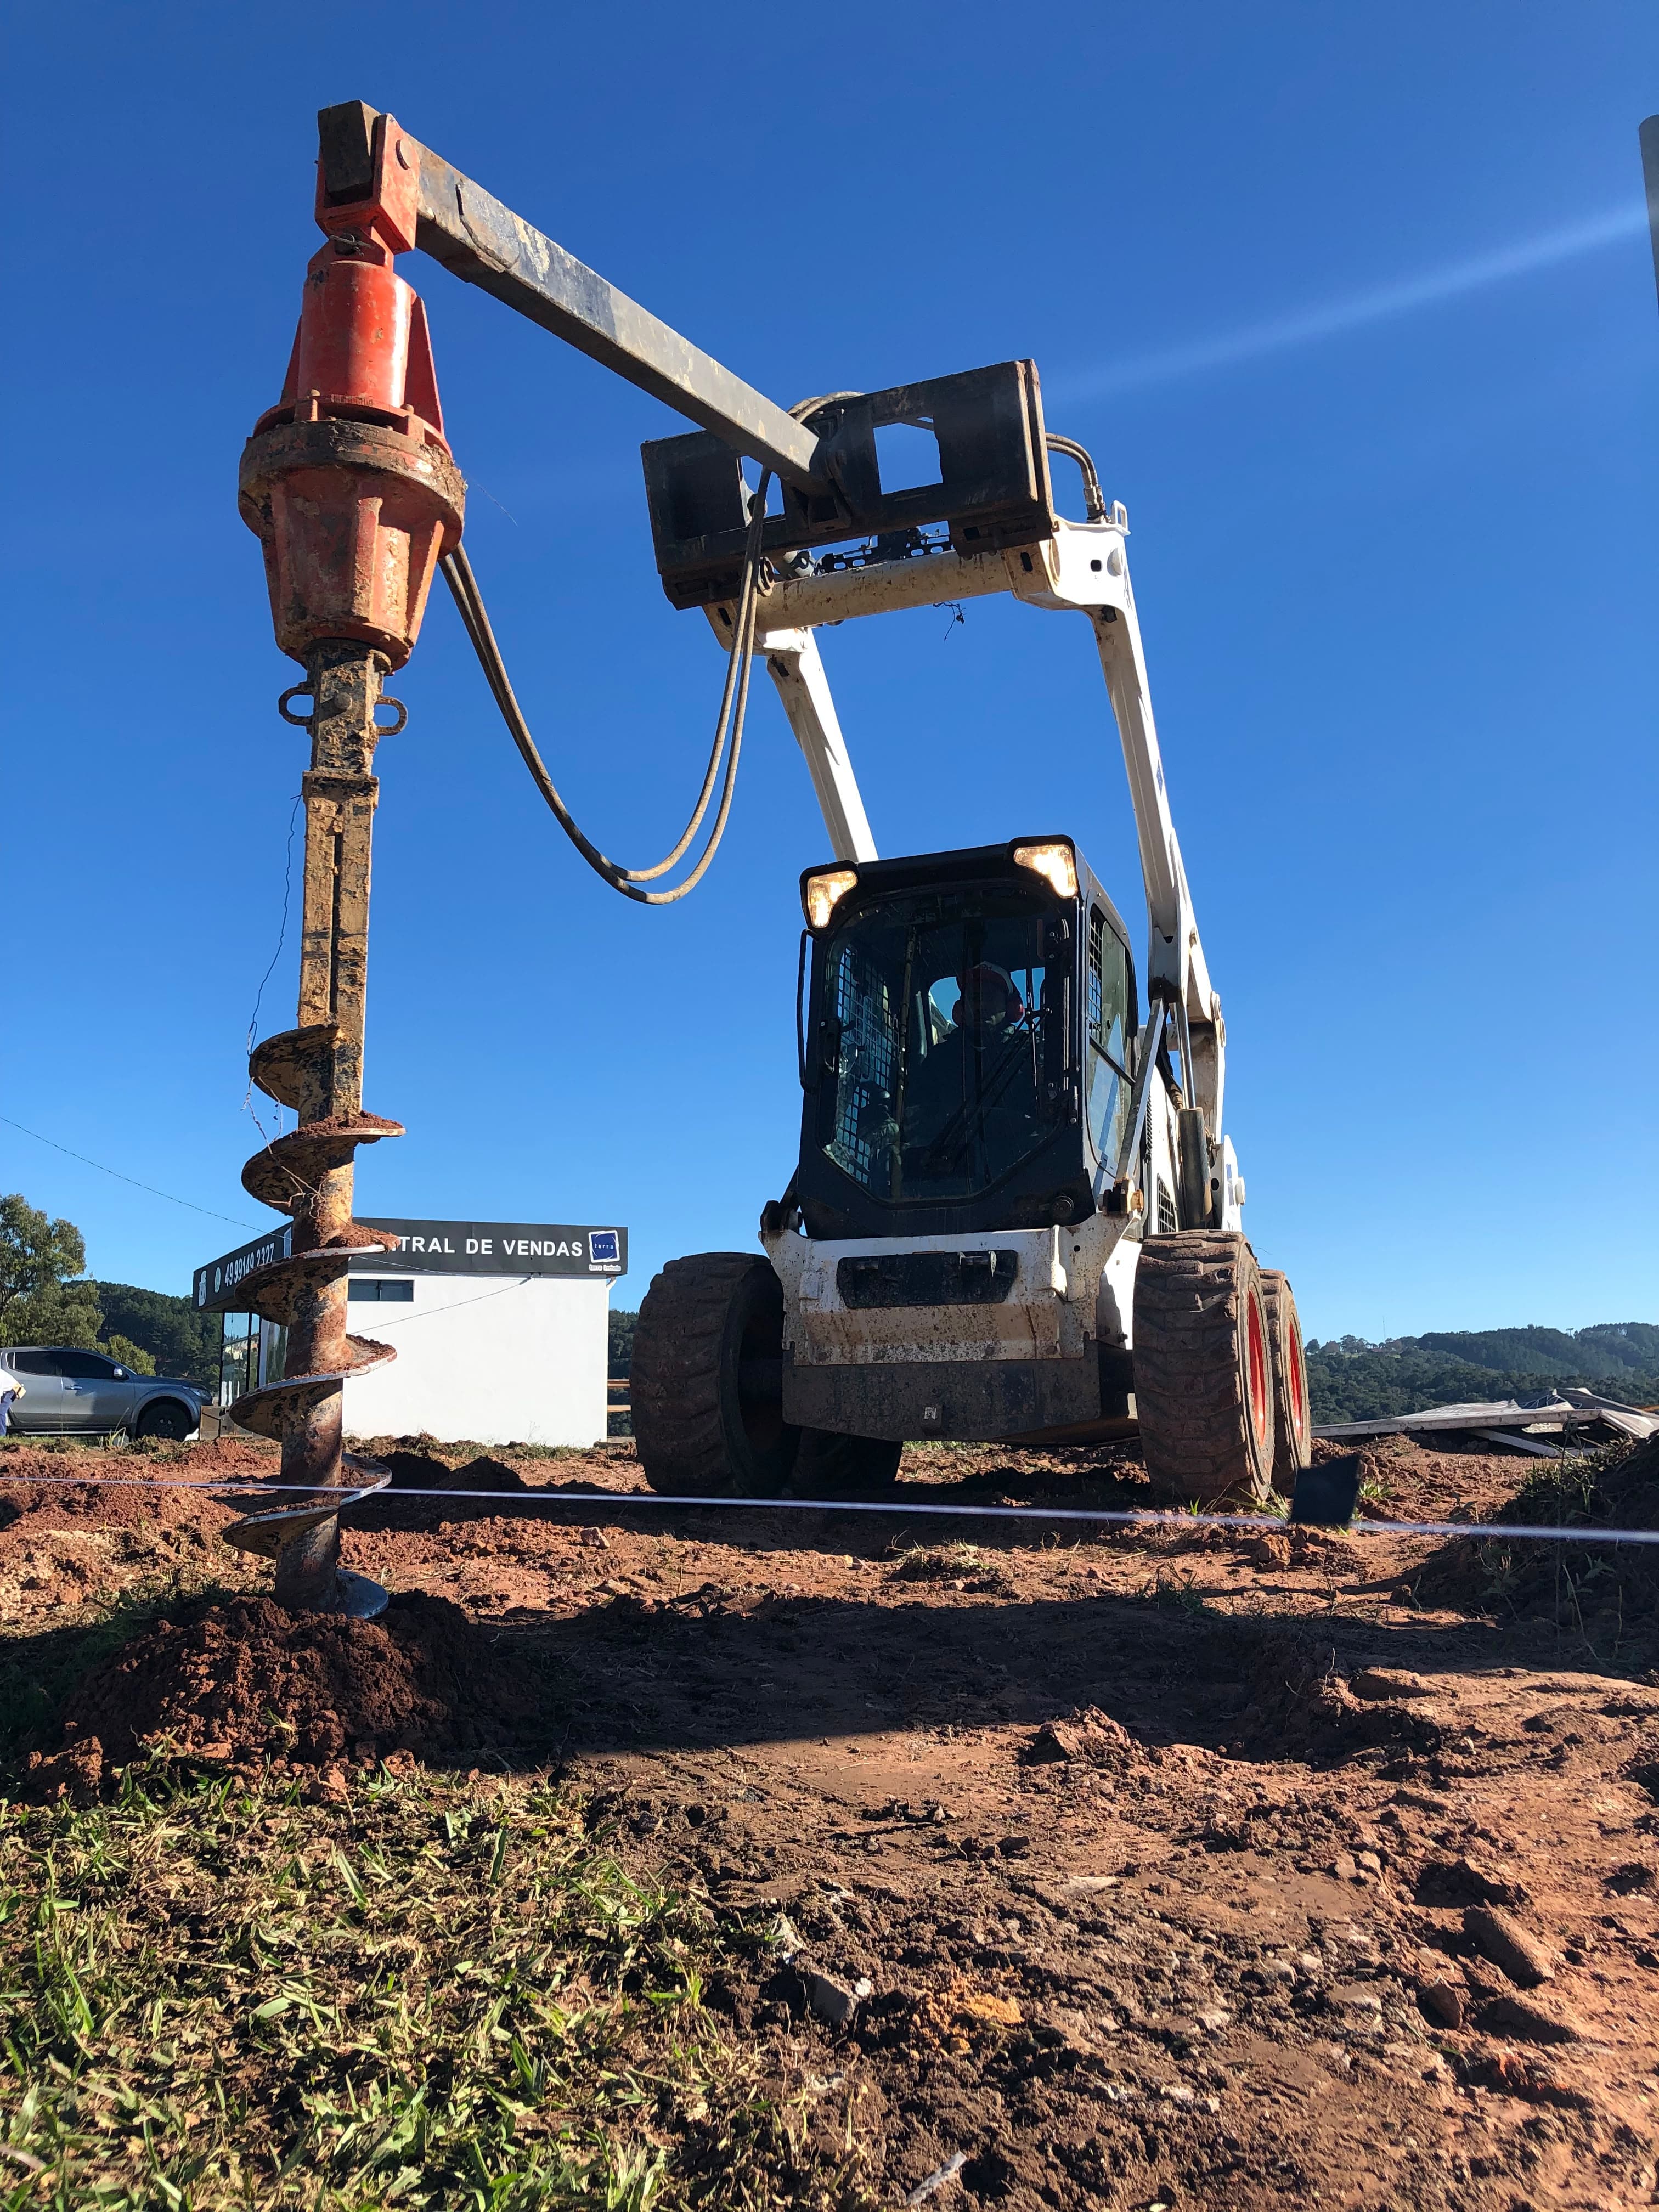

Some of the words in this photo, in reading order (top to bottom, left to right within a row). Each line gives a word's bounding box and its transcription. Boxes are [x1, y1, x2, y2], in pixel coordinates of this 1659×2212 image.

[392, 1236, 455, 1254] TRAL
[466, 1238, 493, 1255] DE
[503, 1239, 583, 1257] VENDAS
[224, 1262, 233, 1287] 49
[234, 1252, 255, 1284] 99149
[256, 1242, 275, 1267] 2327
